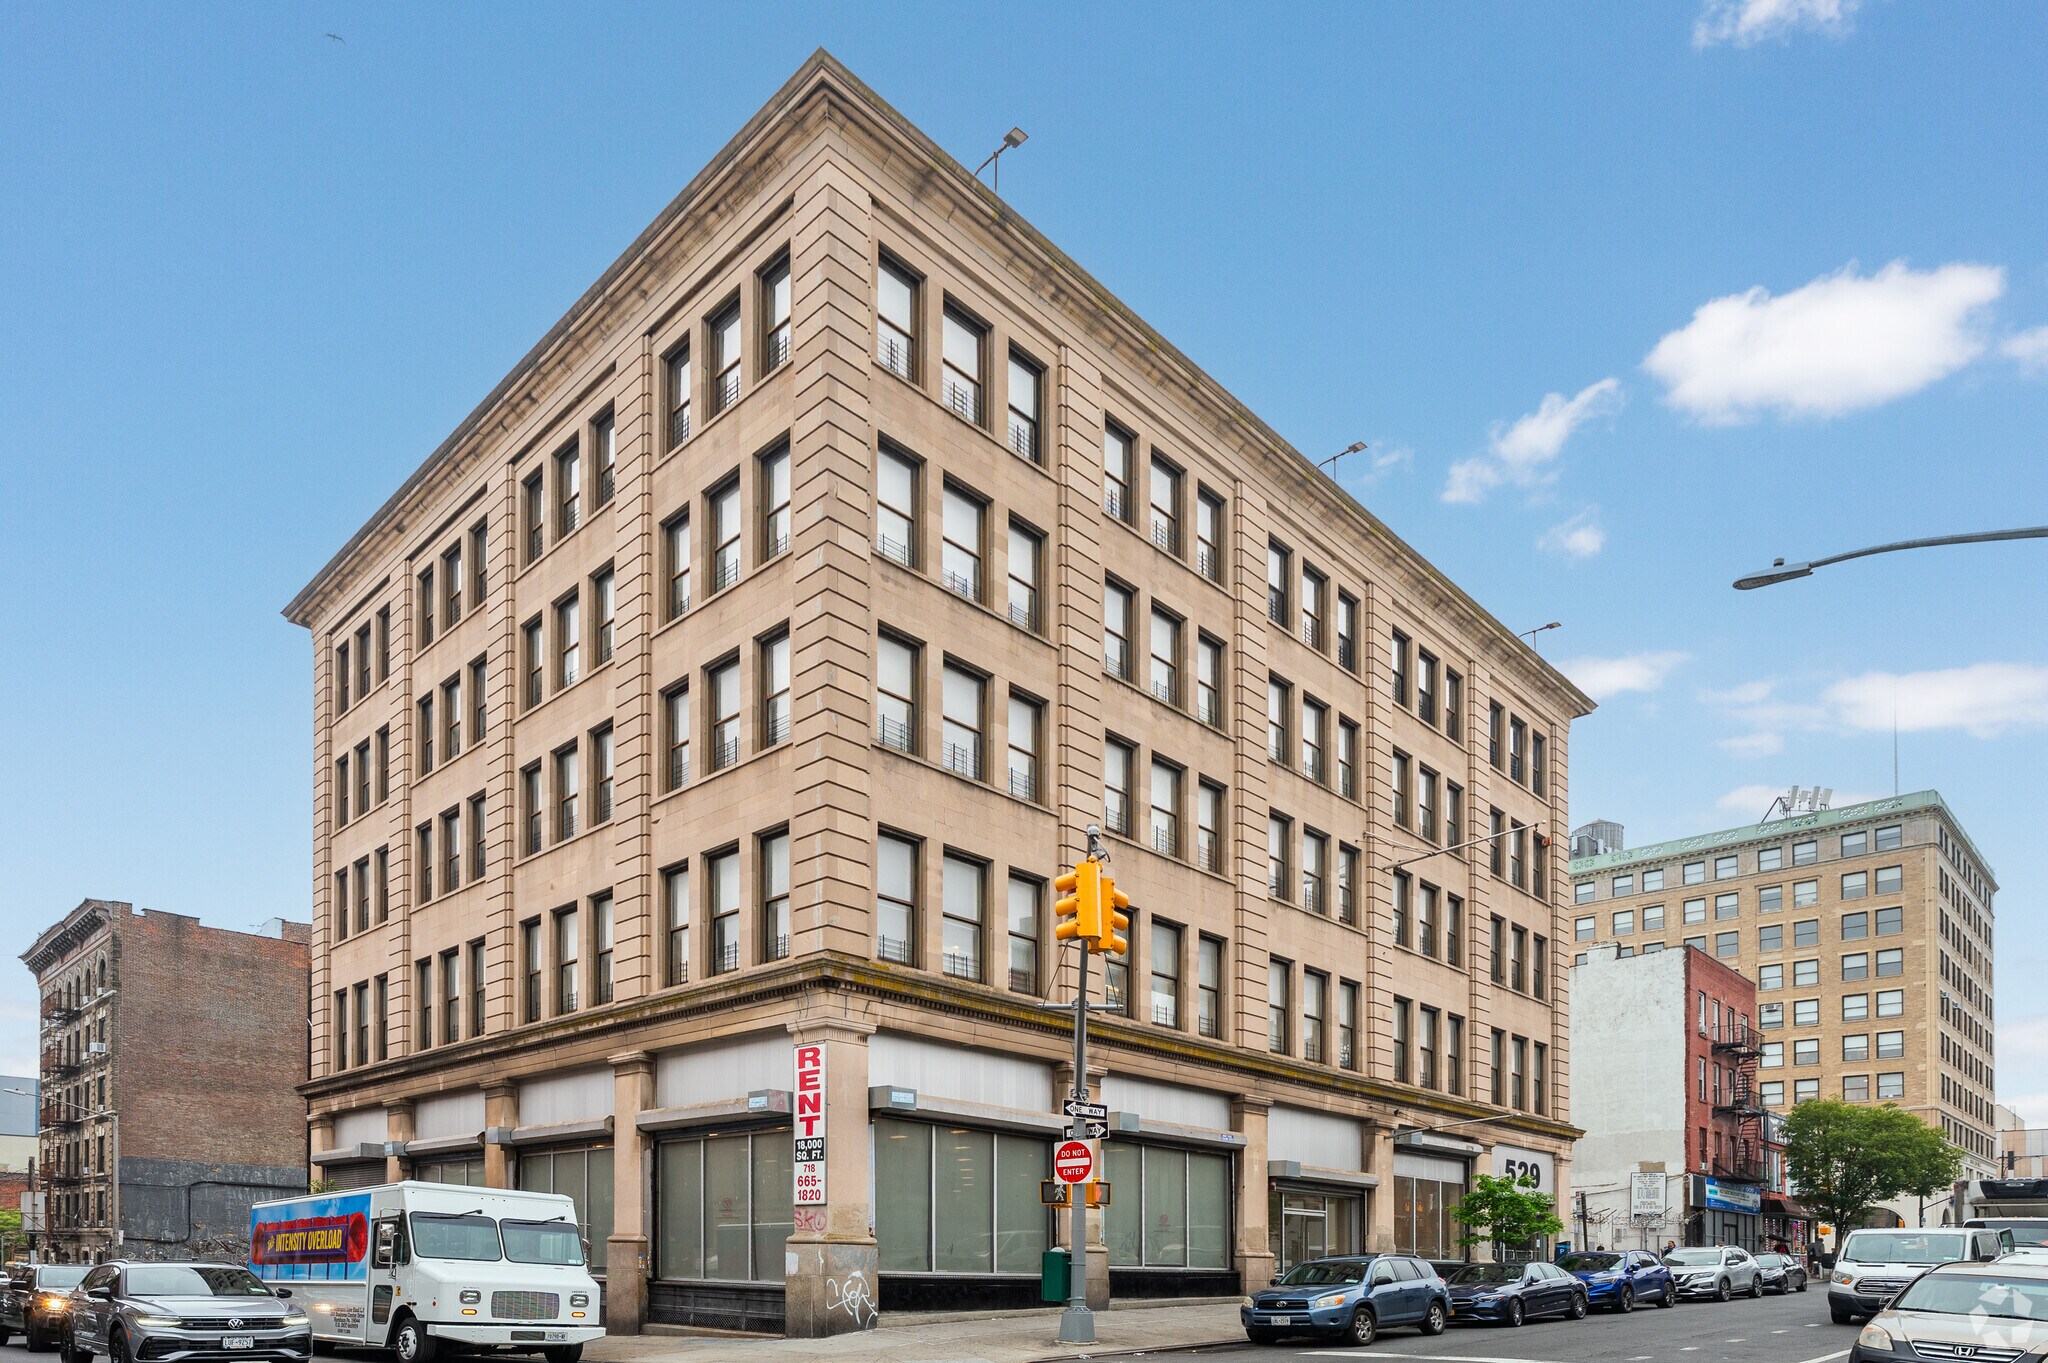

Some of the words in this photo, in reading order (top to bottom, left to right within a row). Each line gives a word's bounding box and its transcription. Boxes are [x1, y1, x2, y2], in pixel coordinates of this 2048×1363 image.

[798, 1046, 821, 1137] RENT
[1070, 1105, 1082, 1113] ONE
[1088, 1126, 1102, 1134] WAY
[796, 1139, 823, 1151] 18,000
[796, 1150, 810, 1161] SQ.
[812, 1150, 824, 1160] FT.
[803, 1163, 816, 1173] 718
[1063, 1168, 1084, 1176] ENTER
[1505, 1158, 1541, 1190] 529
[797, 1175, 822, 1187] 665-
[797, 1188, 822, 1201] 1820
[275, 1231, 307, 1252] INTENSITY
[307, 1229, 343, 1251] OVERLOAD
